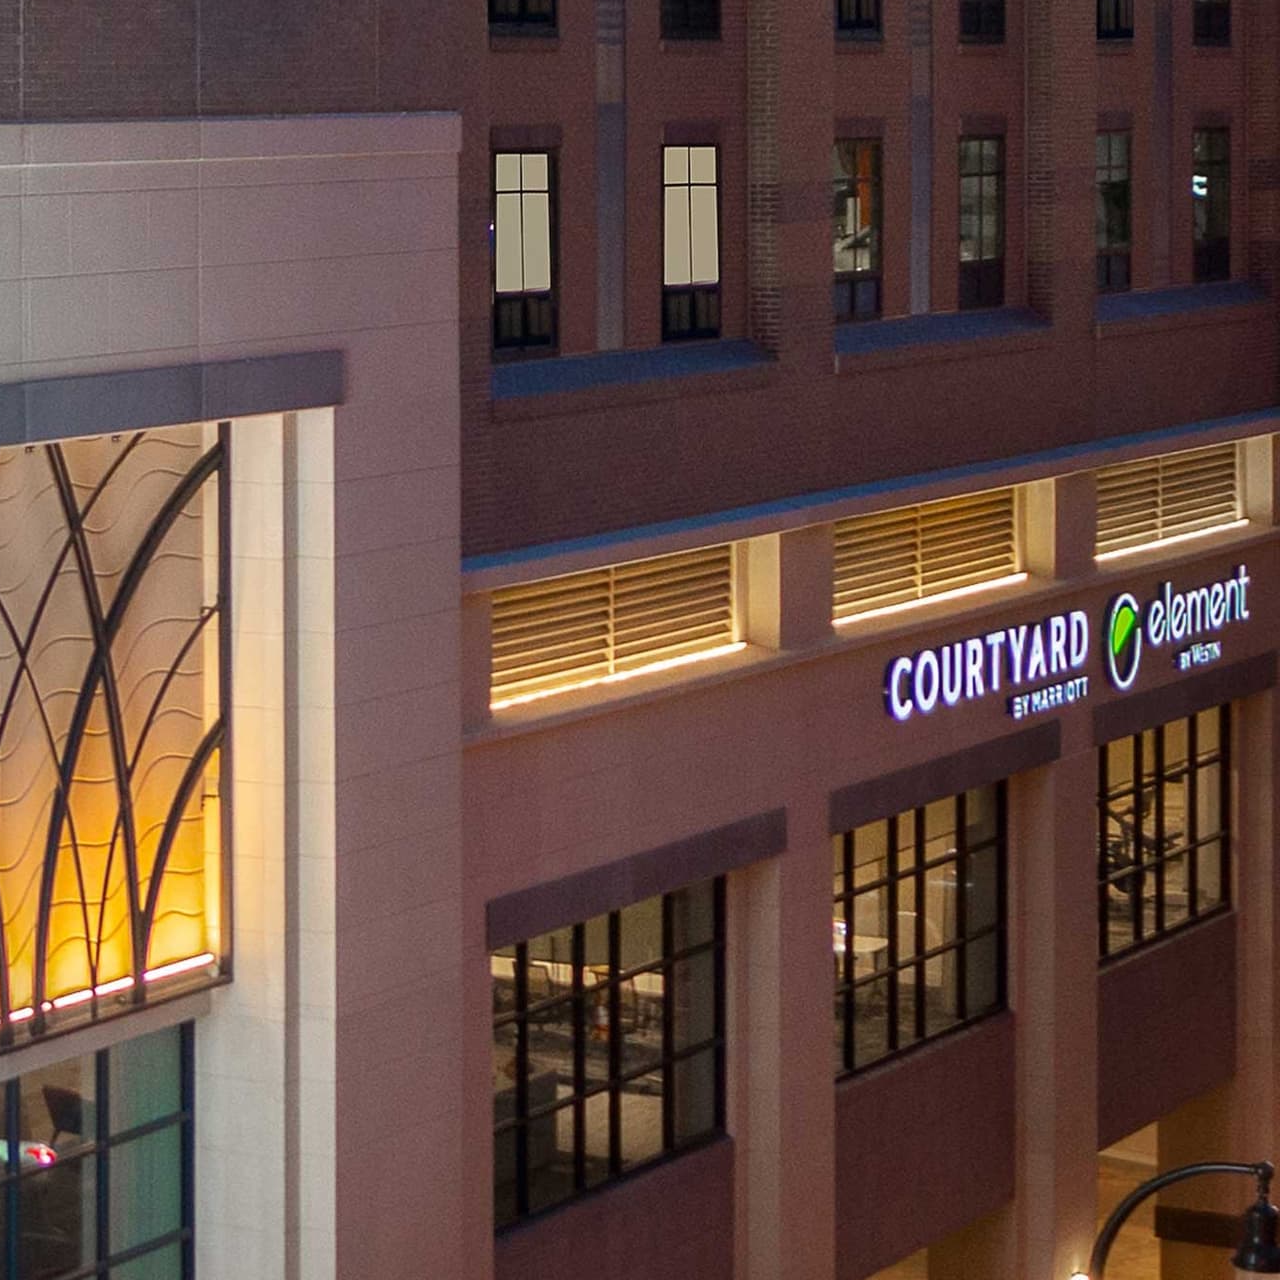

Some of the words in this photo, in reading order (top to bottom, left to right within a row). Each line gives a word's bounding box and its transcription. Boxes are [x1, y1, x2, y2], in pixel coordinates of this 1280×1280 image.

[1148, 564, 1251, 646] element
[886, 609, 1090, 721] COURTYARD
[1010, 693, 1030, 720] BY
[1031, 675, 1090, 714] MARRIOTT
